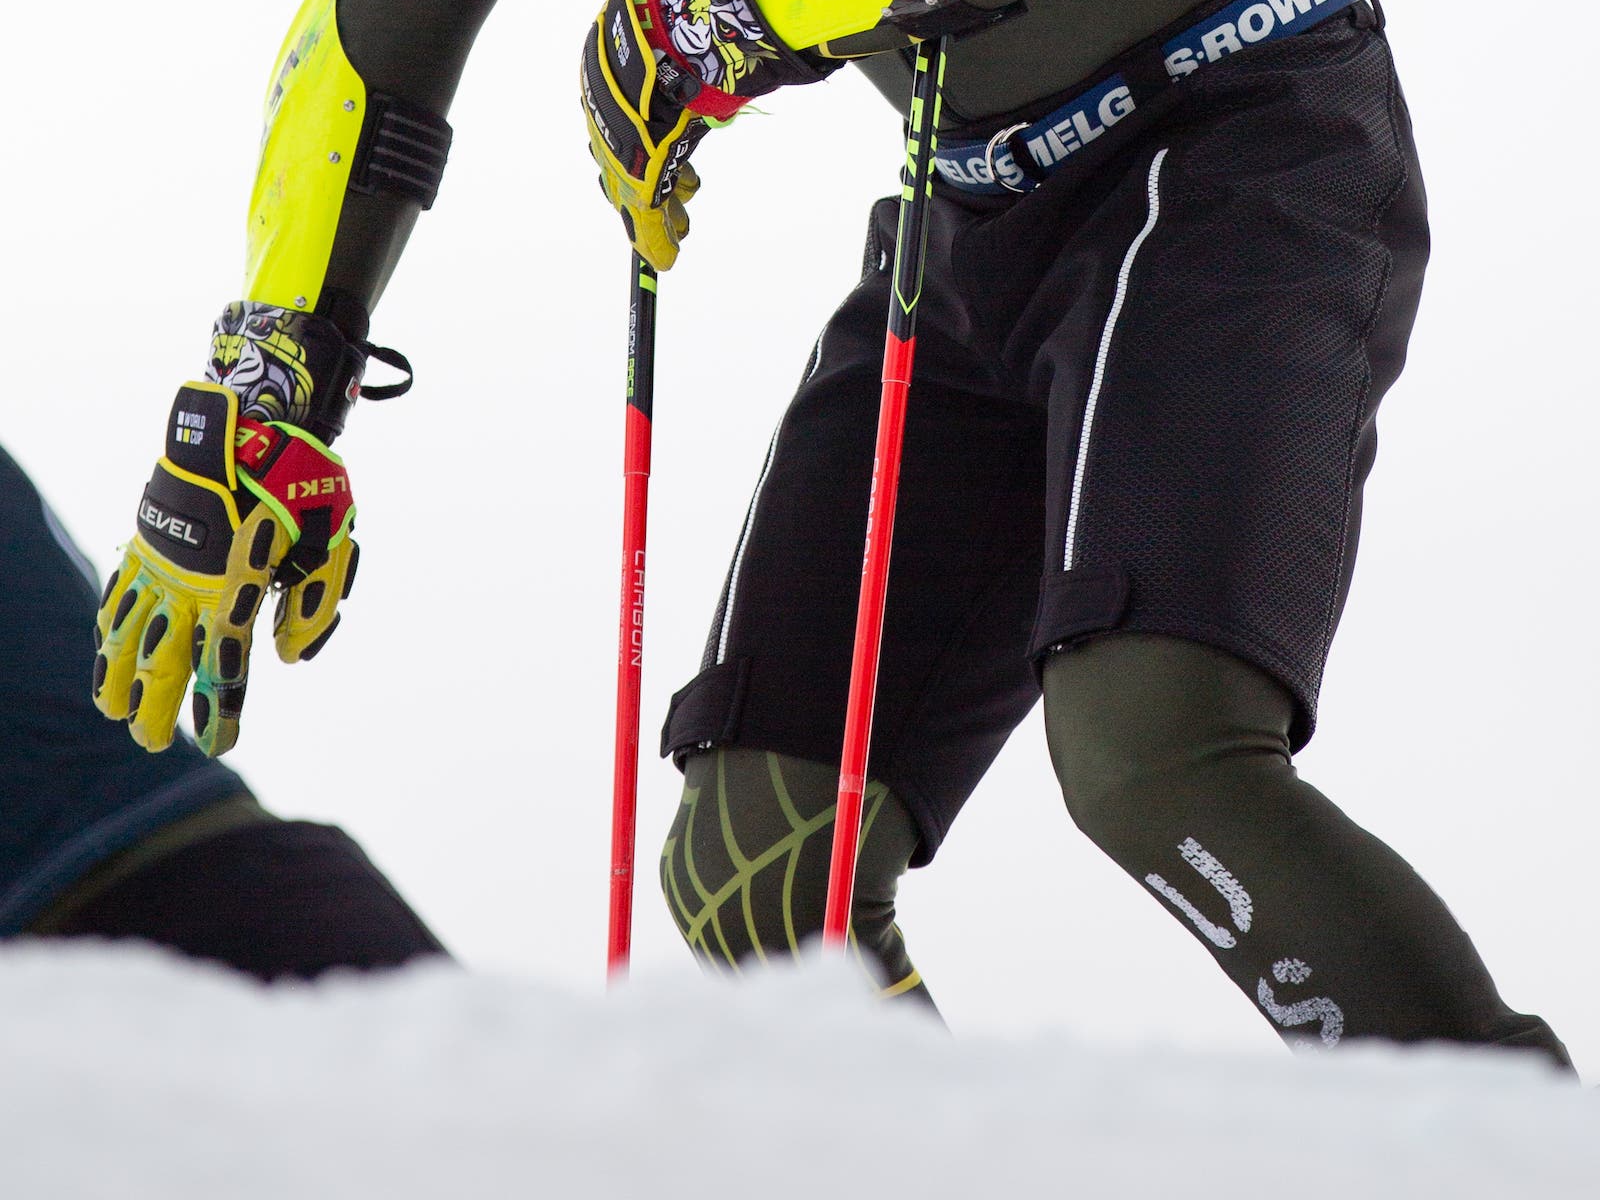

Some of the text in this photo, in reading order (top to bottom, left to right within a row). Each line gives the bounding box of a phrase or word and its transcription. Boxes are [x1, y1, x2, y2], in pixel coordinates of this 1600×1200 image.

[660, 69, 680, 86] ONE
[184, 412, 207, 430] WORLD
[189, 429, 204, 446] CUP
[287, 475, 347, 500] LEKI
[139, 499, 199, 545] LEVEL
